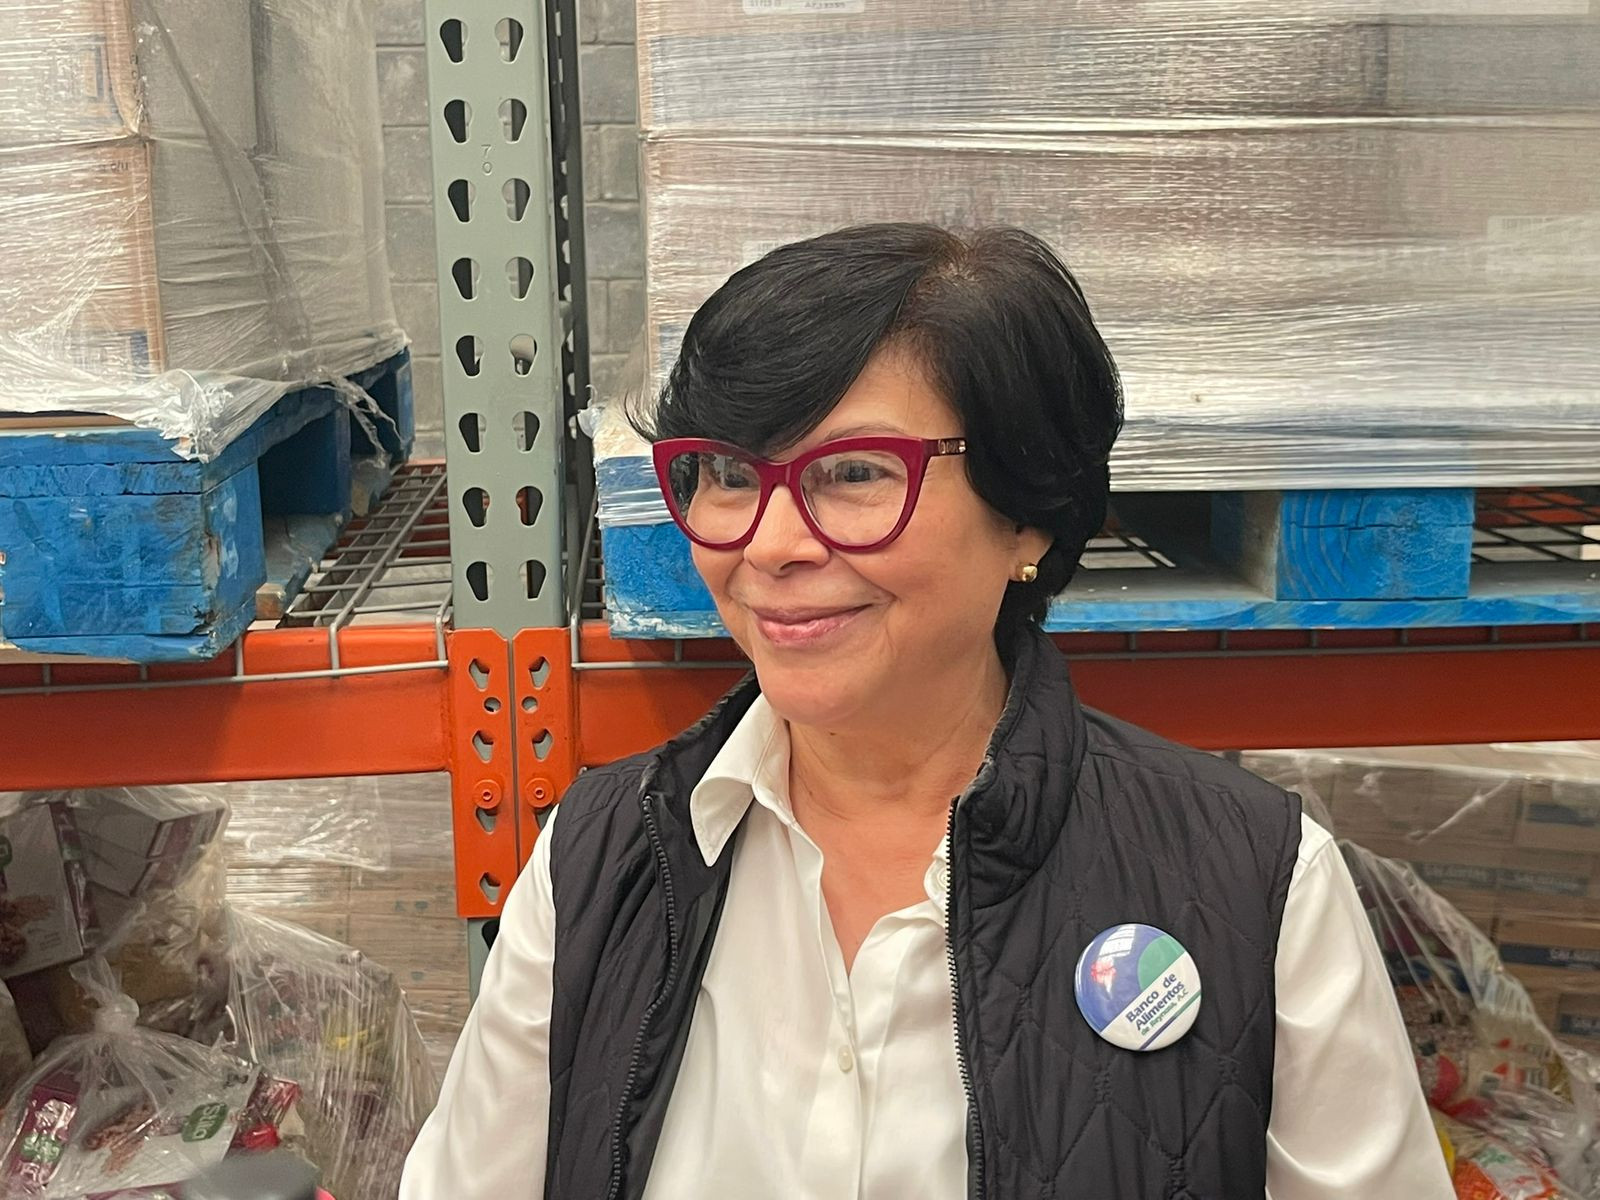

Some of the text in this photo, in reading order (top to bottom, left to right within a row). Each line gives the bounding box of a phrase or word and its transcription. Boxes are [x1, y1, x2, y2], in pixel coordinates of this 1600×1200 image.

[1126, 973, 1177, 1023] Banco de
[1136, 981, 1185, 1031] Alimentos
